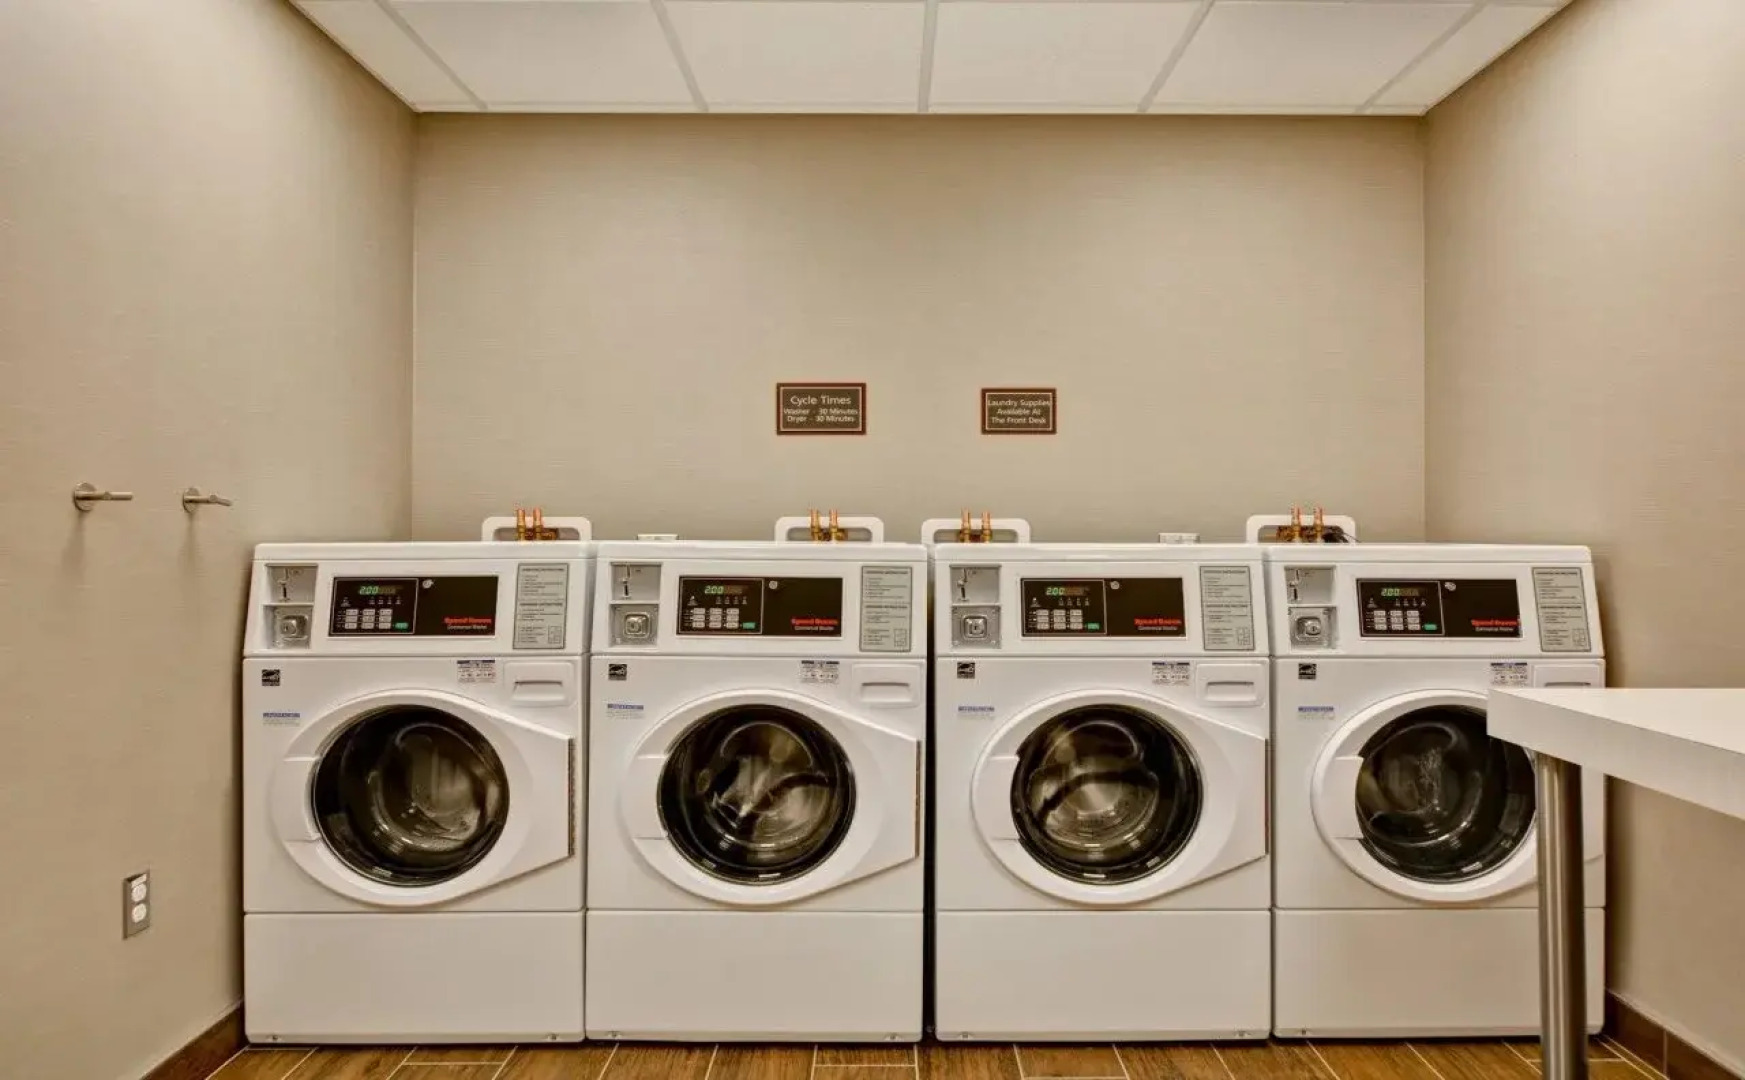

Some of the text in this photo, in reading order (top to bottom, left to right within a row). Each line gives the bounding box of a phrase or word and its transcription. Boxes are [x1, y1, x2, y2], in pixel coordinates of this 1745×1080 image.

[790, 395, 852, 407] Cycle Times
[987, 399, 1052, 407] Laundry Supplies
[783, 407, 810, 415] Washer
[829, 407, 858, 415] Minutes
[787, 415, 807, 423] Dryer
